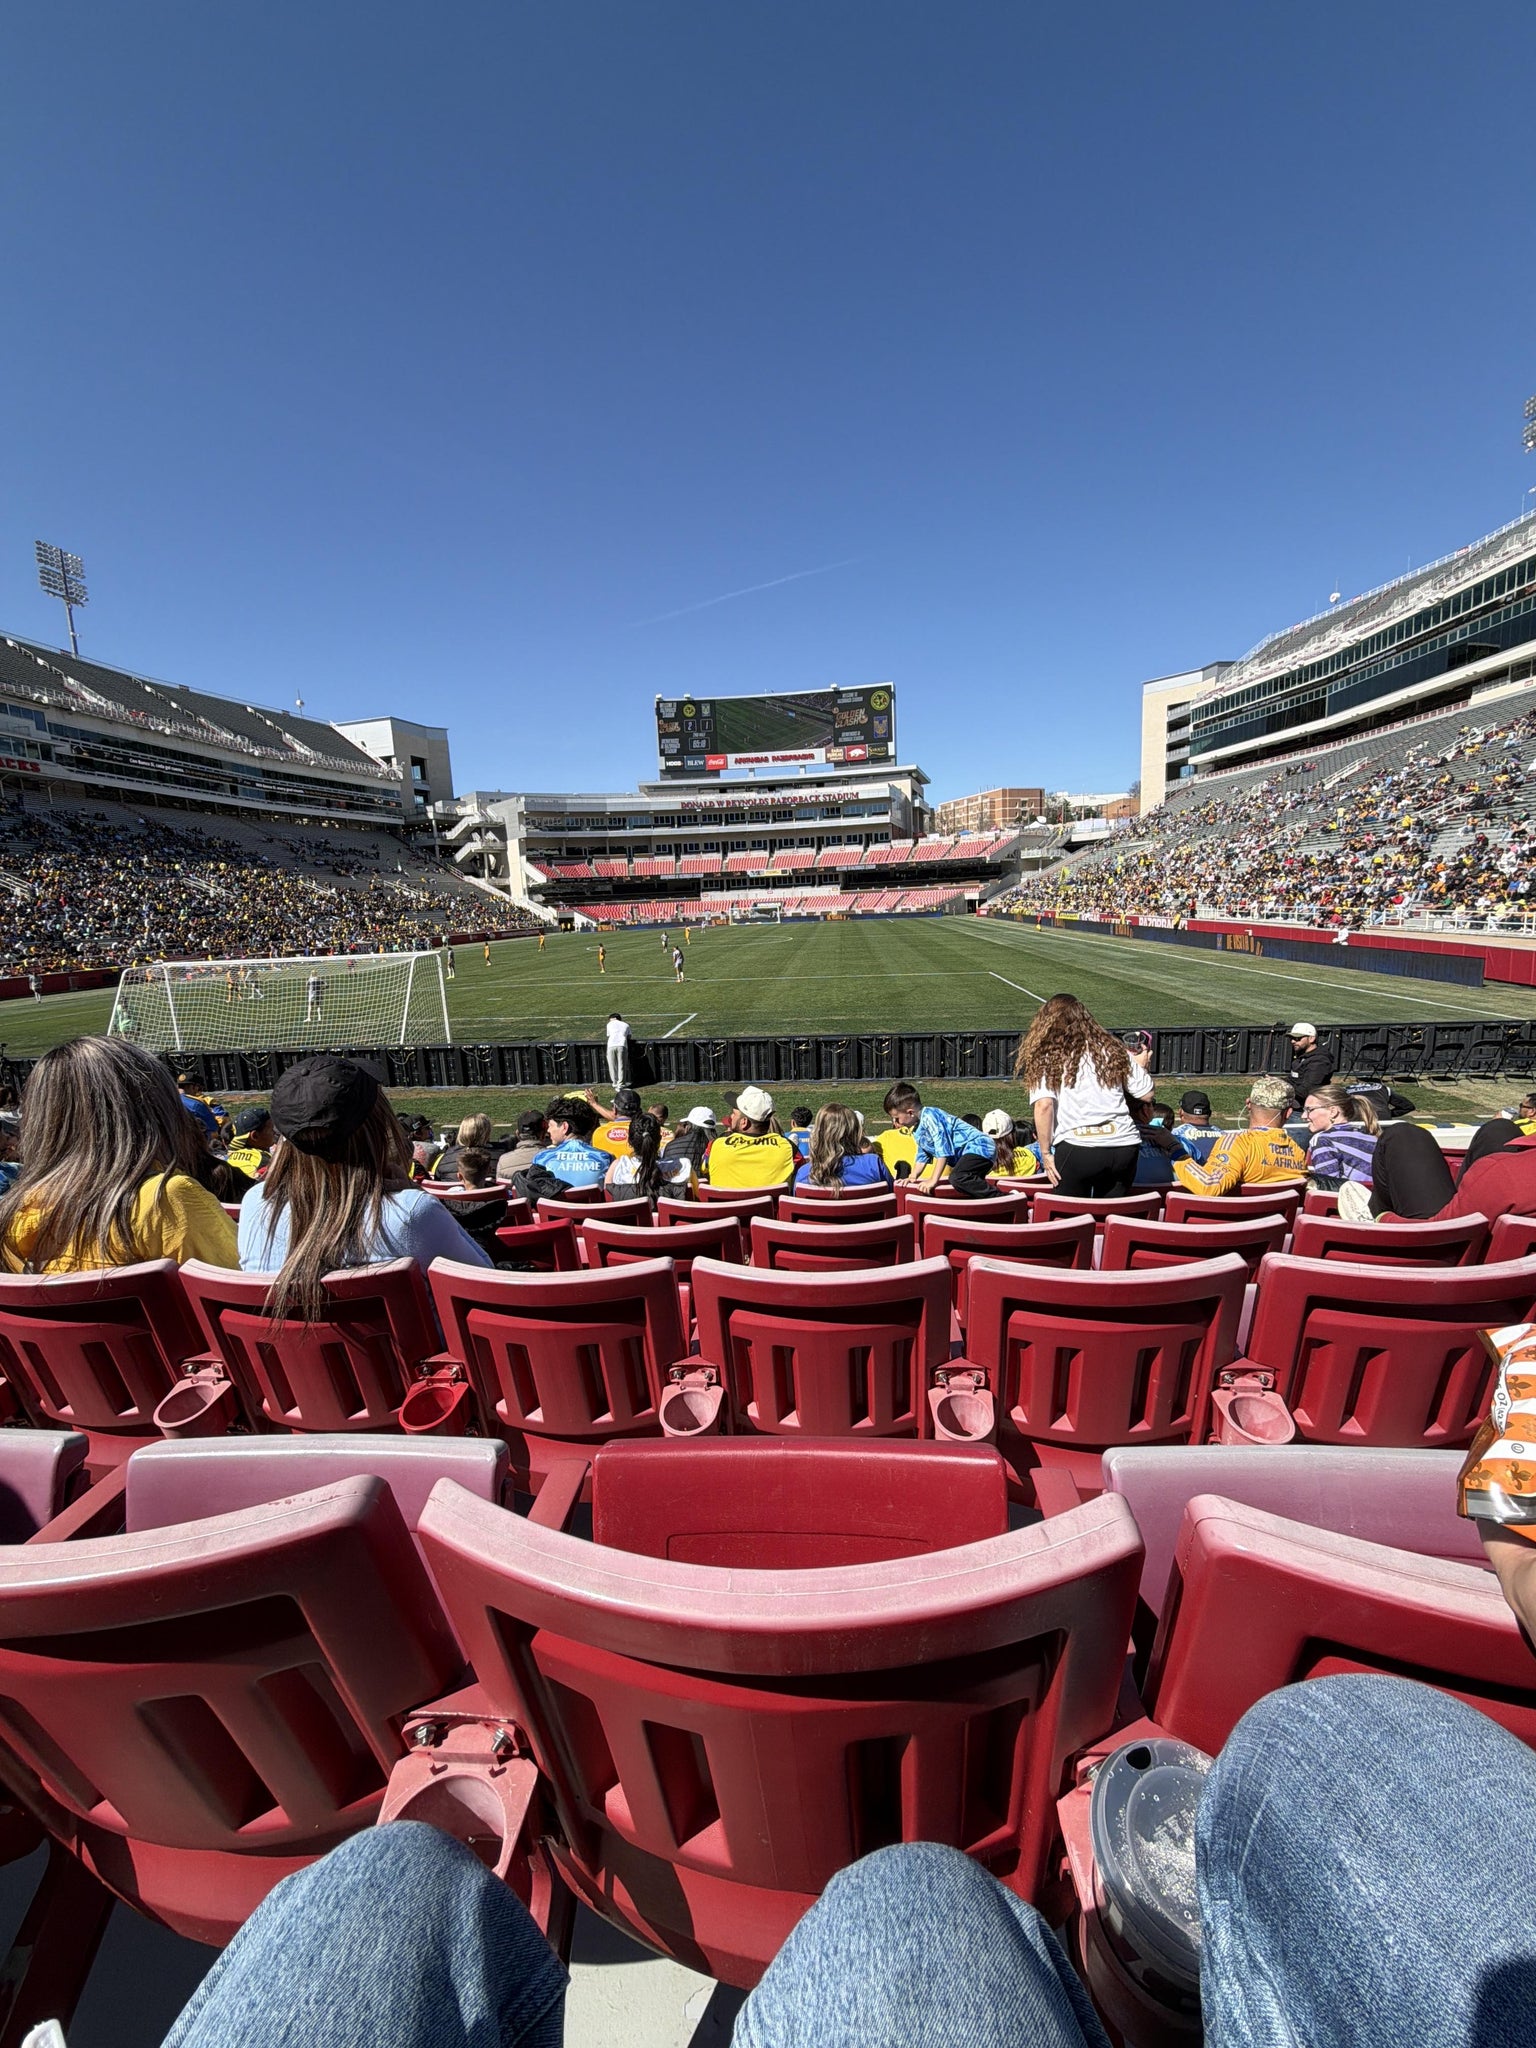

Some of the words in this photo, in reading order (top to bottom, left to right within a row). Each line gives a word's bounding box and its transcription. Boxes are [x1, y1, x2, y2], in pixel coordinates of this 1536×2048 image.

[687, 721, 693, 731] 2
[681, 801, 715, 809] DONALD
[716, 800, 725, 808] W
[726, 798, 769, 808] REYNOLDS
[771, 795, 820, 806] RAZORBACK
[822, 792, 859, 801] STADIUM
[725, 1136, 778, 1148] Corona
[1268, 1142, 1294, 1157] TECATE
[555, 1151, 589, 1161] TECATE
[558, 1161, 601, 1171] AFIRME
[1274, 1158, 1306, 1170] AFIRME
